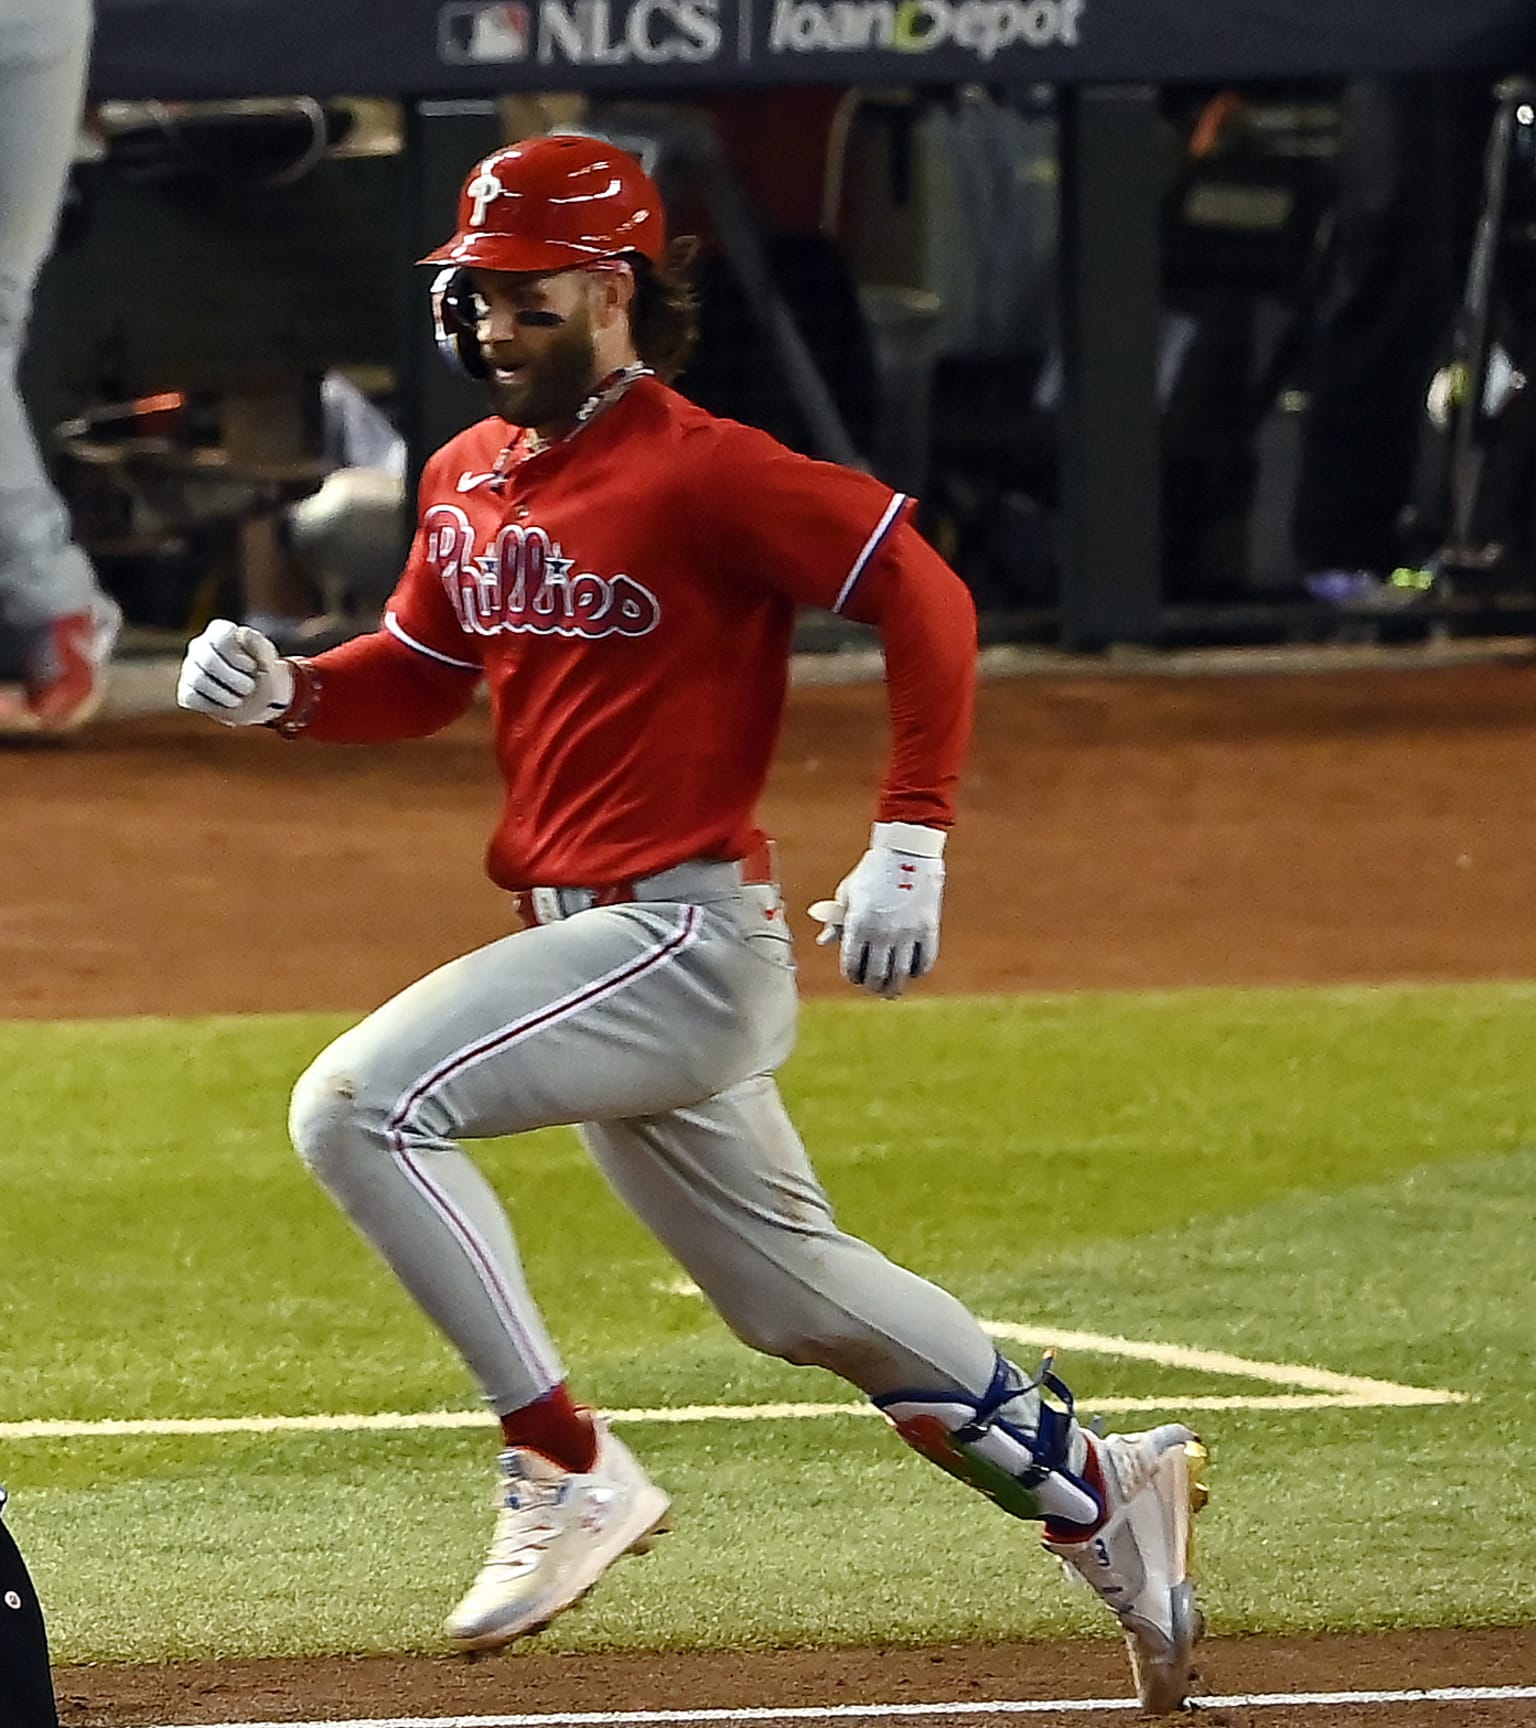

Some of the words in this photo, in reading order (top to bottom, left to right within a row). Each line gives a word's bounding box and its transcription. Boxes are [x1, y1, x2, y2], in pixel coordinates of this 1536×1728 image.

[537, 0, 722, 65] NLCS
[768, 0, 1086, 62] loanDepot
[467, 172, 503, 227] P
[424, 503, 661, 639] Phillies
